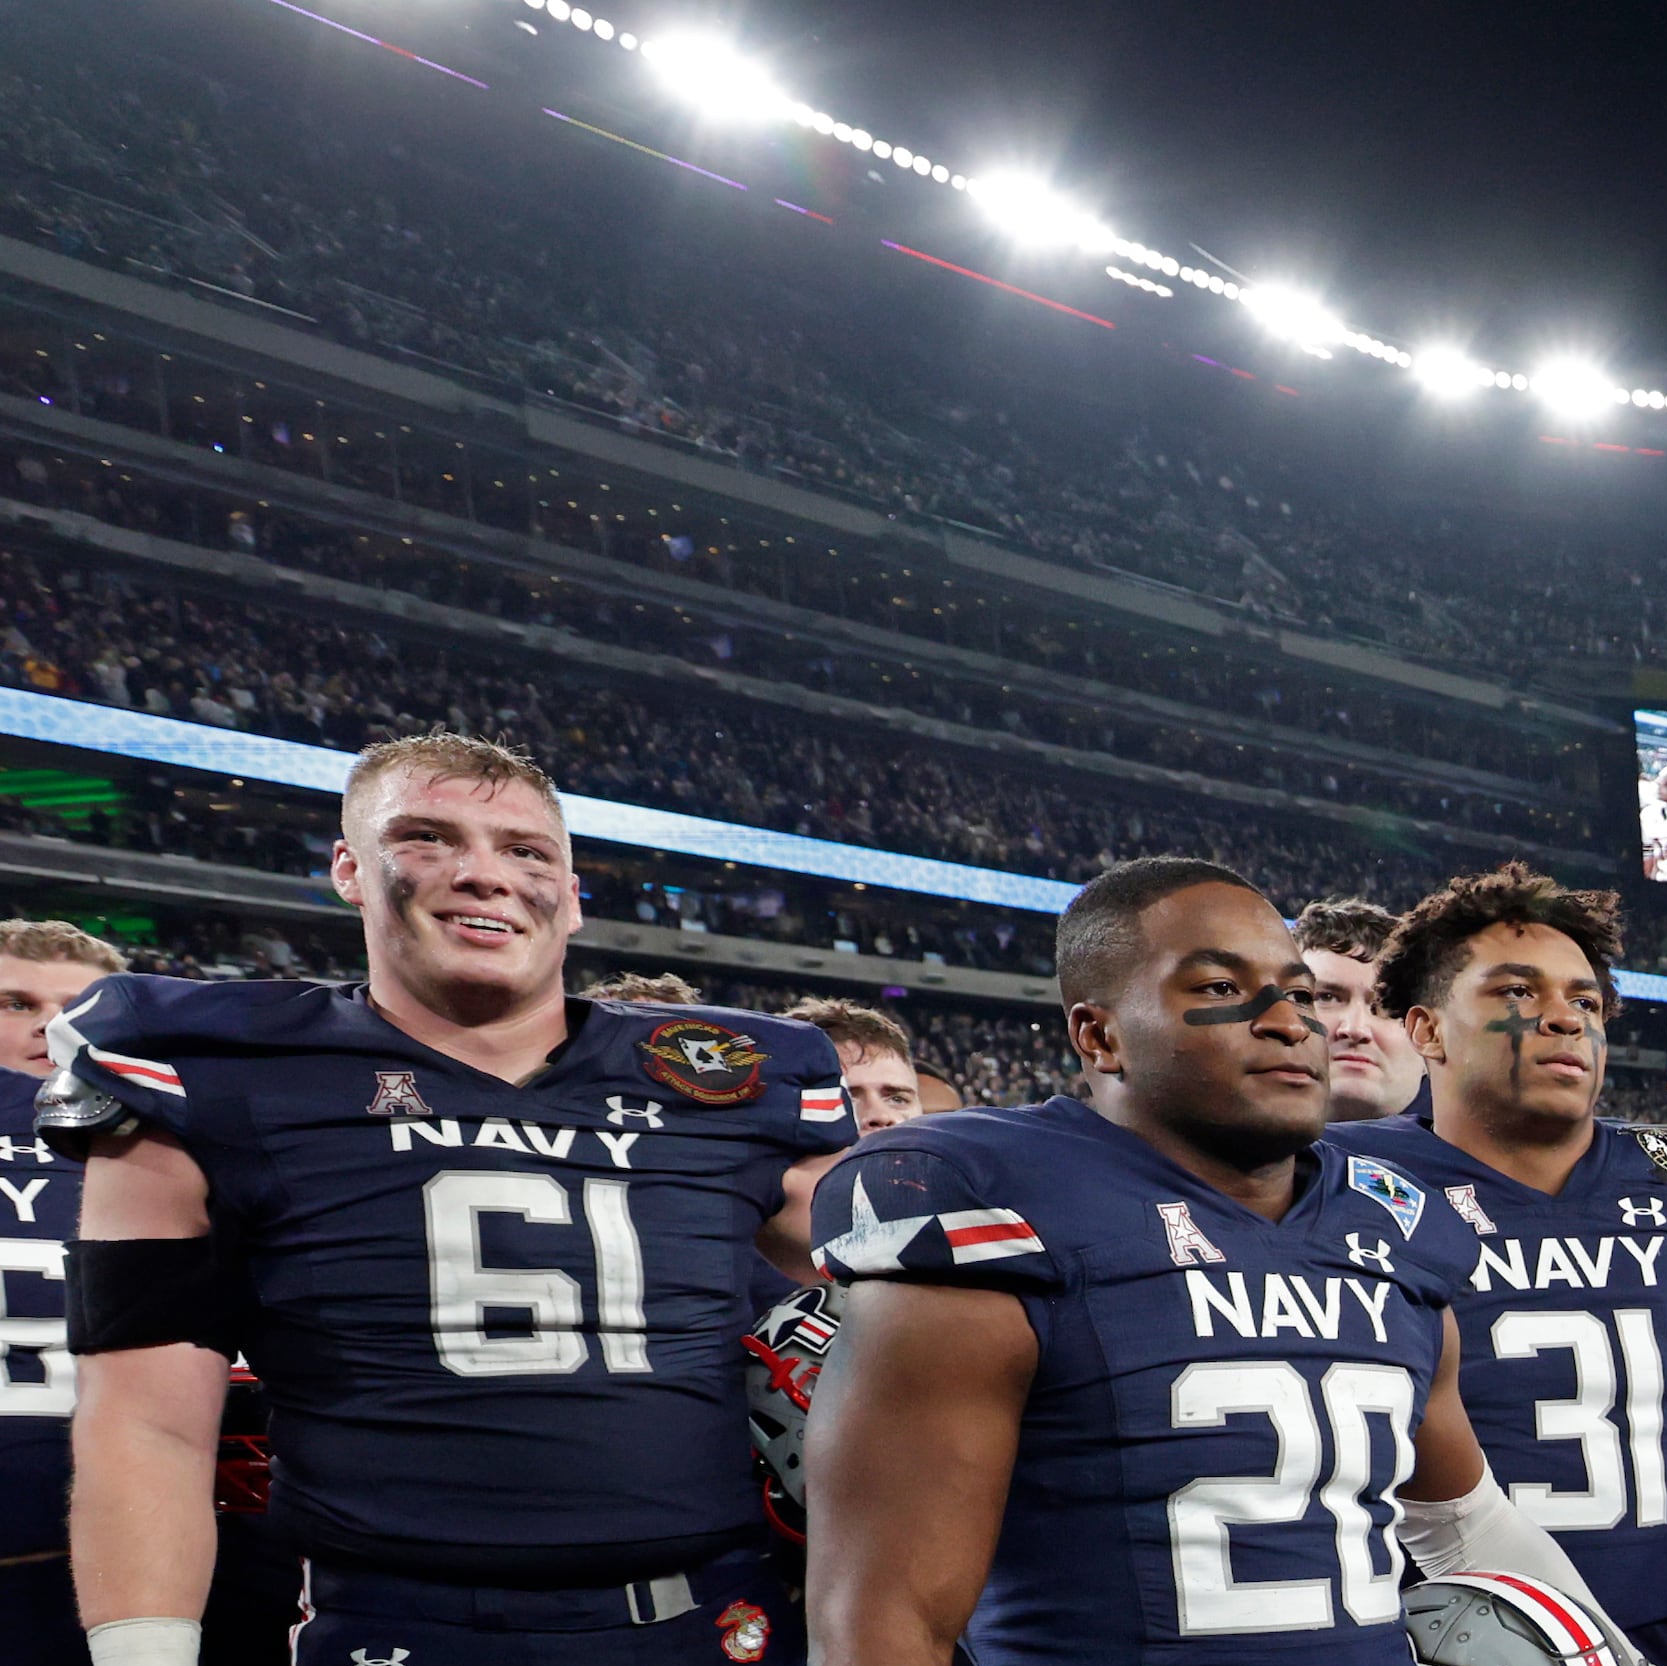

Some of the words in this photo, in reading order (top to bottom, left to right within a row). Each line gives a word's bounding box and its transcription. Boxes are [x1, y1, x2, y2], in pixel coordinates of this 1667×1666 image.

[390, 1116, 640, 1170] NAVY
[0, 1237, 79, 1417] 6
[422, 1169, 655, 1378] 61
[1185, 1269, 1392, 1344] NAVY
[1471, 1235, 1665, 1293] NAVY
[1167, 1360, 1417, 1638] 20
